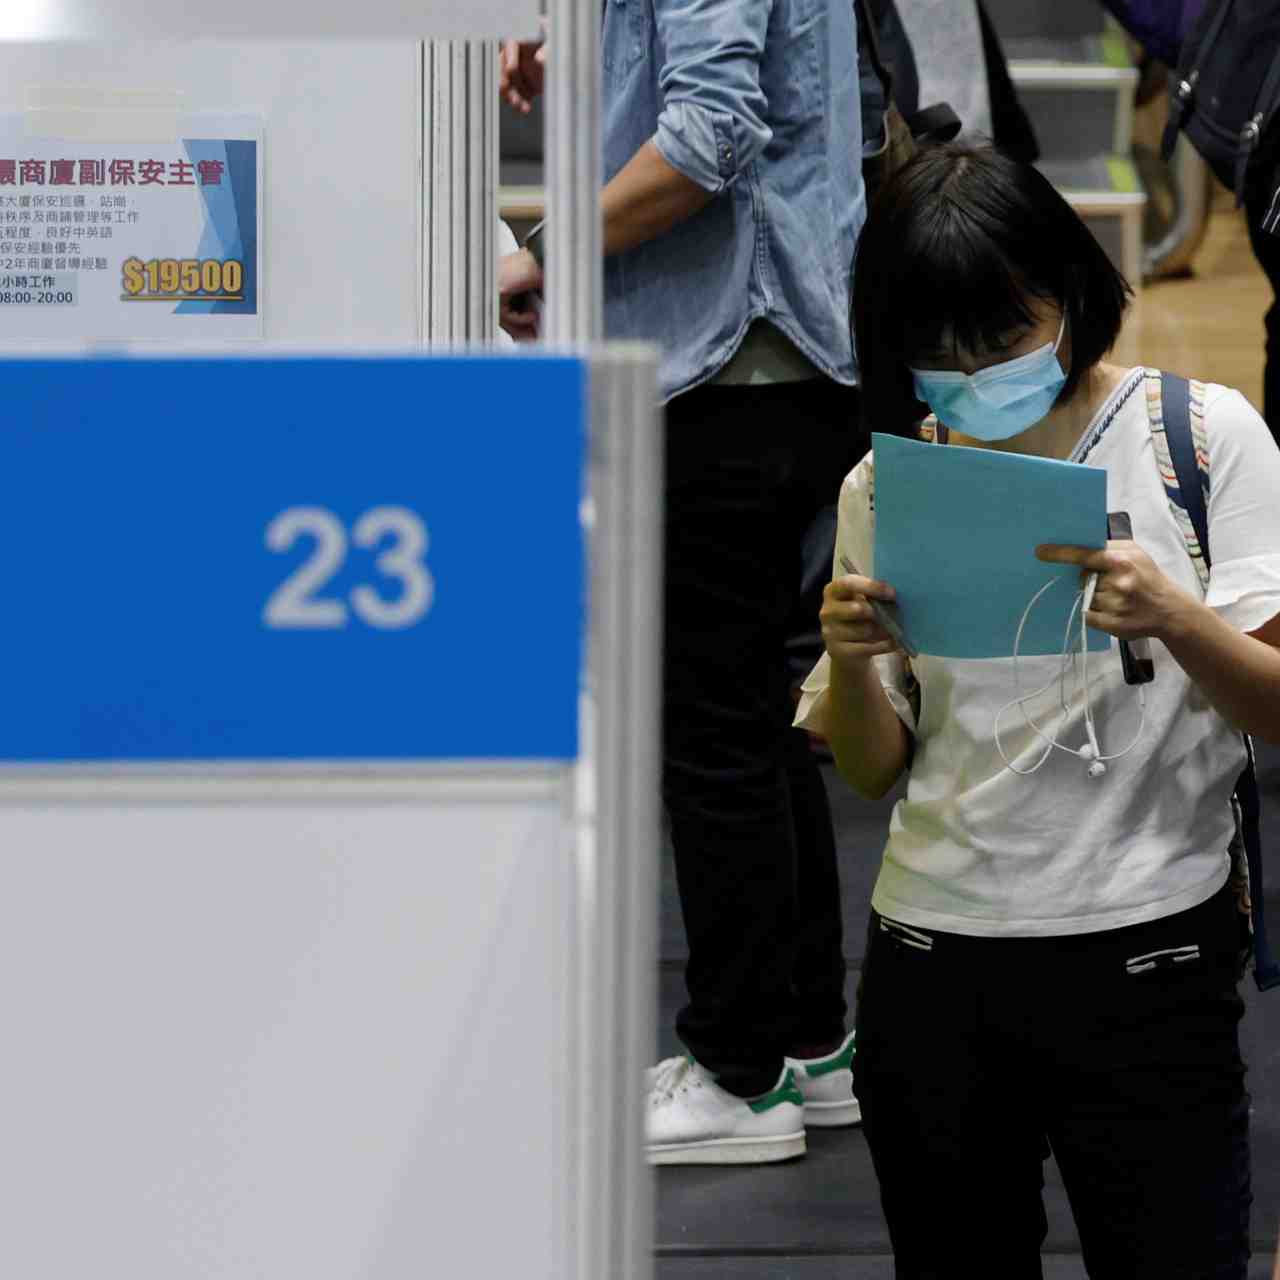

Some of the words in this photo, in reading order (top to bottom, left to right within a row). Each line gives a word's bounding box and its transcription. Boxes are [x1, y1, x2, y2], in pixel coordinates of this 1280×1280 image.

[0, 275, 55, 288] 小時工作
[122, 257, 244, 295] $19500
[262, 505, 435, 629] 23
